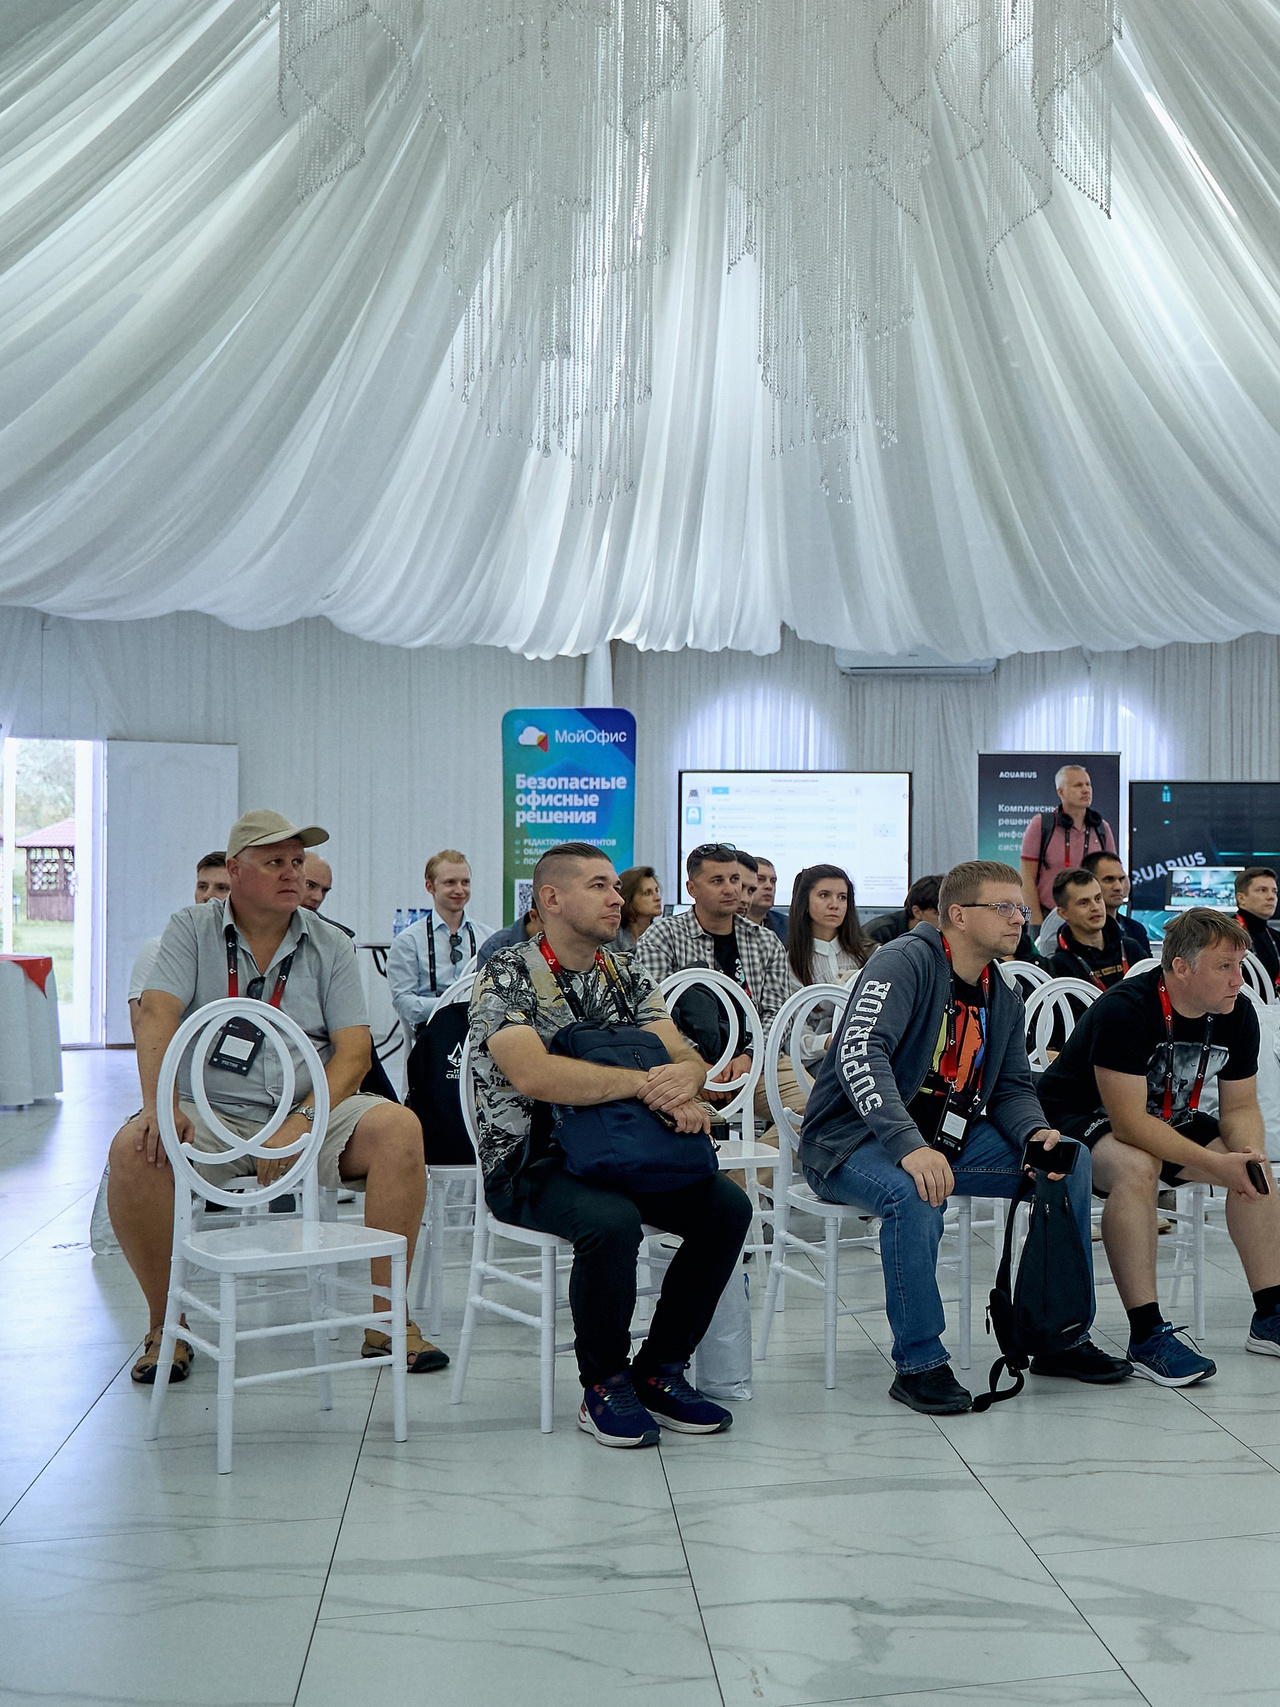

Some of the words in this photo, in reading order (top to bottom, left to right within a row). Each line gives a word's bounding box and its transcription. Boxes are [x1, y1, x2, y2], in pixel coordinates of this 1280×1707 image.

[555, 730, 627, 746] МойОфис
[515, 774, 628, 790] Безопасные
[999, 771, 1038, 779] AQUARIUS
[515, 790, 600, 810] офисные
[515, 810, 597, 828] решения
[841, 980, 892, 1116] SUPERIOR
